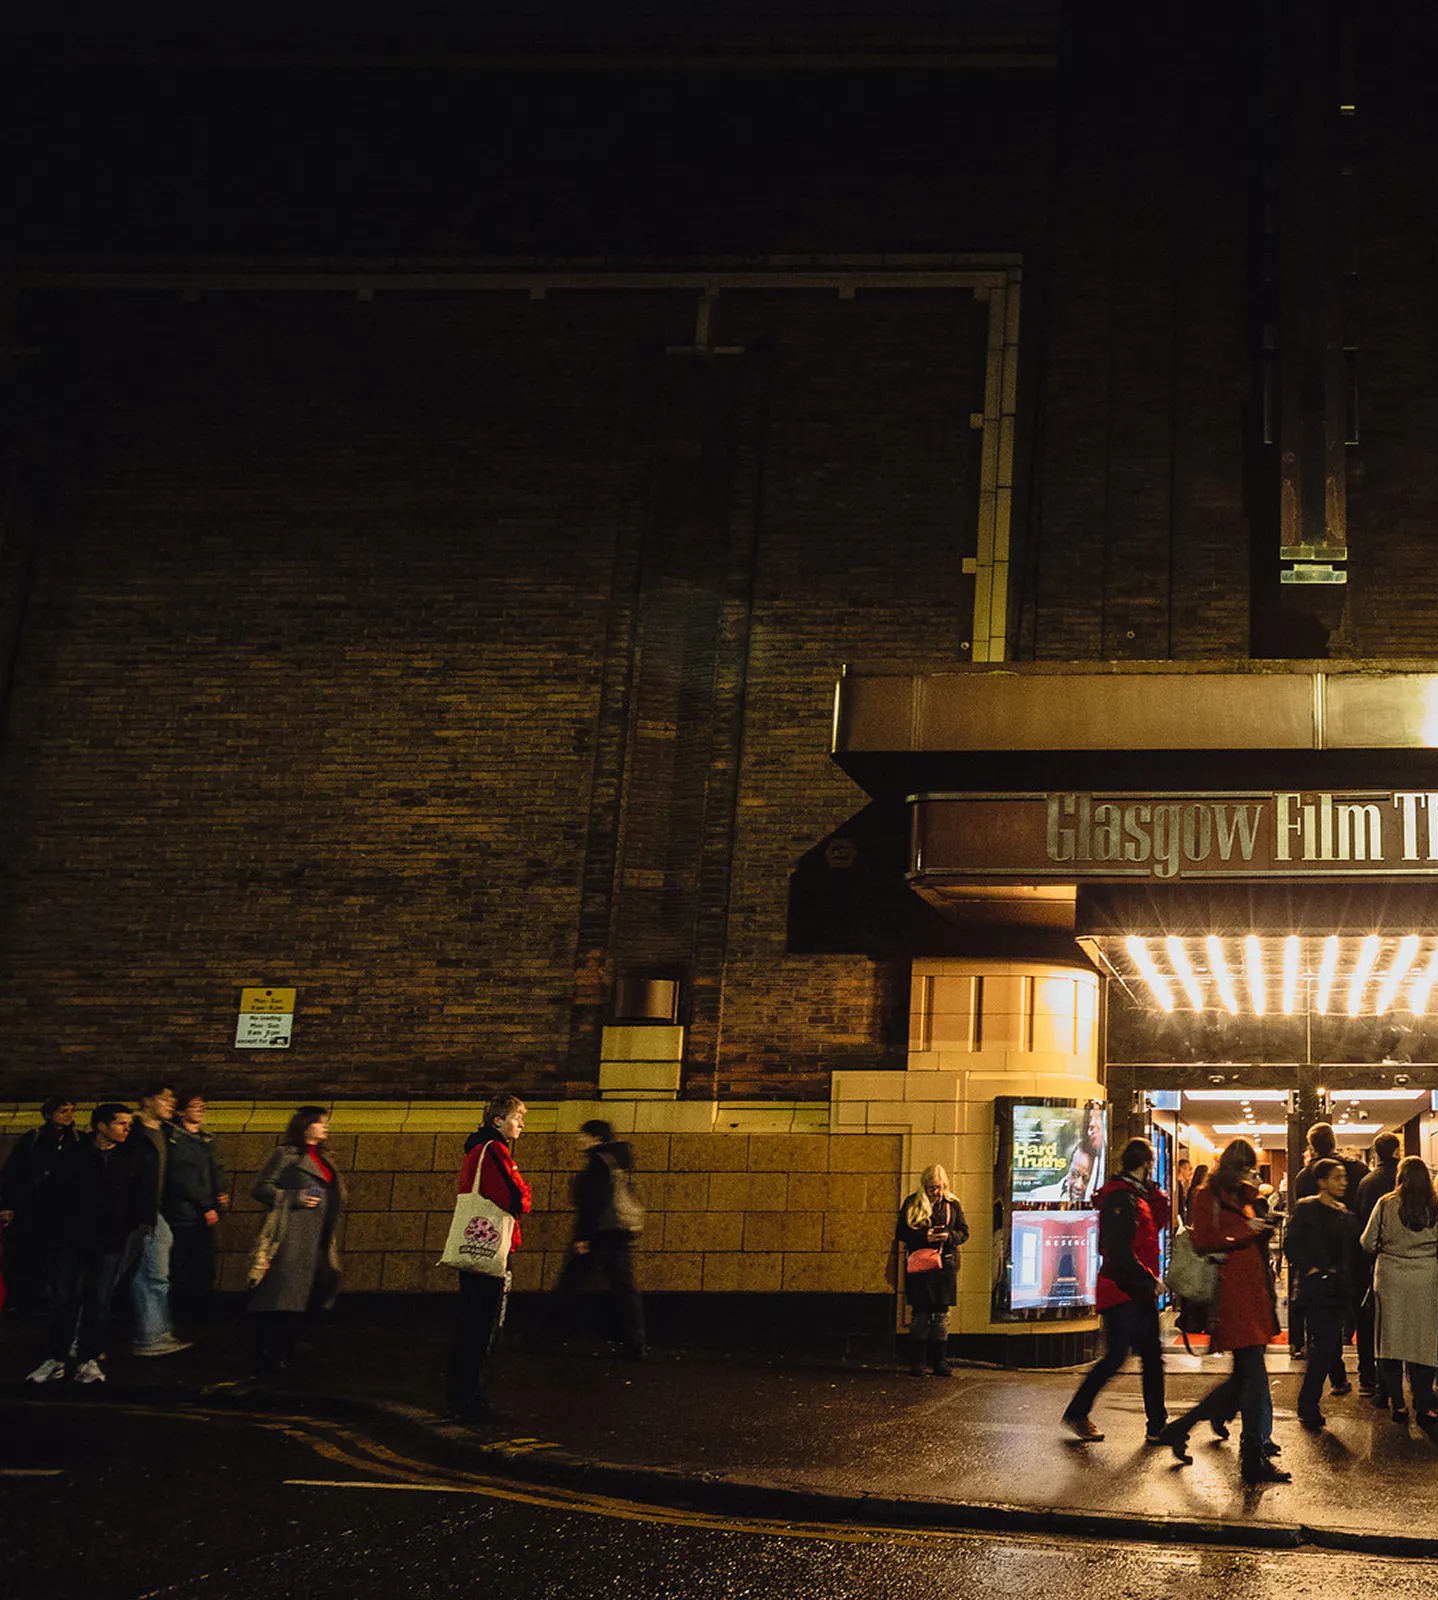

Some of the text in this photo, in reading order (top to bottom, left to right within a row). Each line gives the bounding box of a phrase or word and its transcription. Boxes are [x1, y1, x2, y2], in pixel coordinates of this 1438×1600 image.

[1046, 793, 1264, 878] Glasgow
[1273, 792, 1385, 861] Film
[1014, 1142, 1058, 1158] Hard
[1015, 1155, 1067, 1169] Truths
